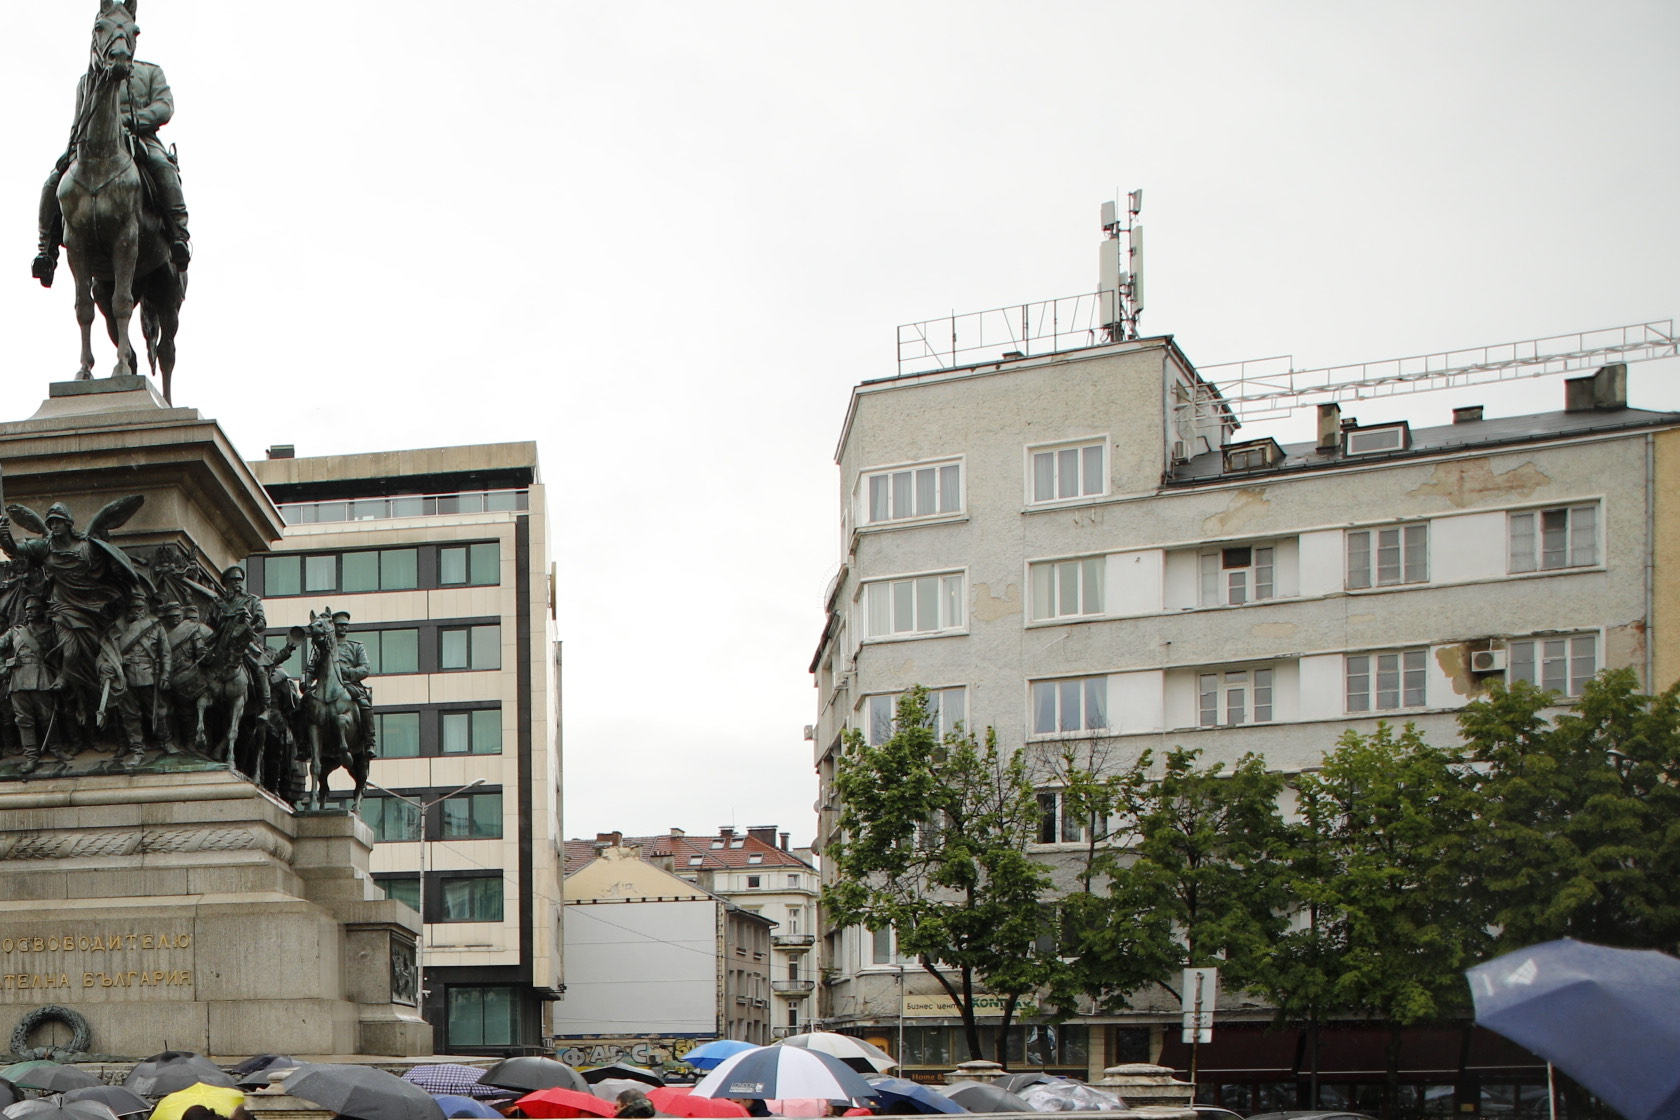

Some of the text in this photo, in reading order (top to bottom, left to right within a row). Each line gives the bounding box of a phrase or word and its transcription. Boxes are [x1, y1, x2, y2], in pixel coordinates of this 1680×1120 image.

[2, 933, 190, 954] ОСВОБОДИТЕЛЮ
[82, 970, 192, 988] БЪЛГАРИЯ
[907, 1002, 933, 1010] Бизнес
